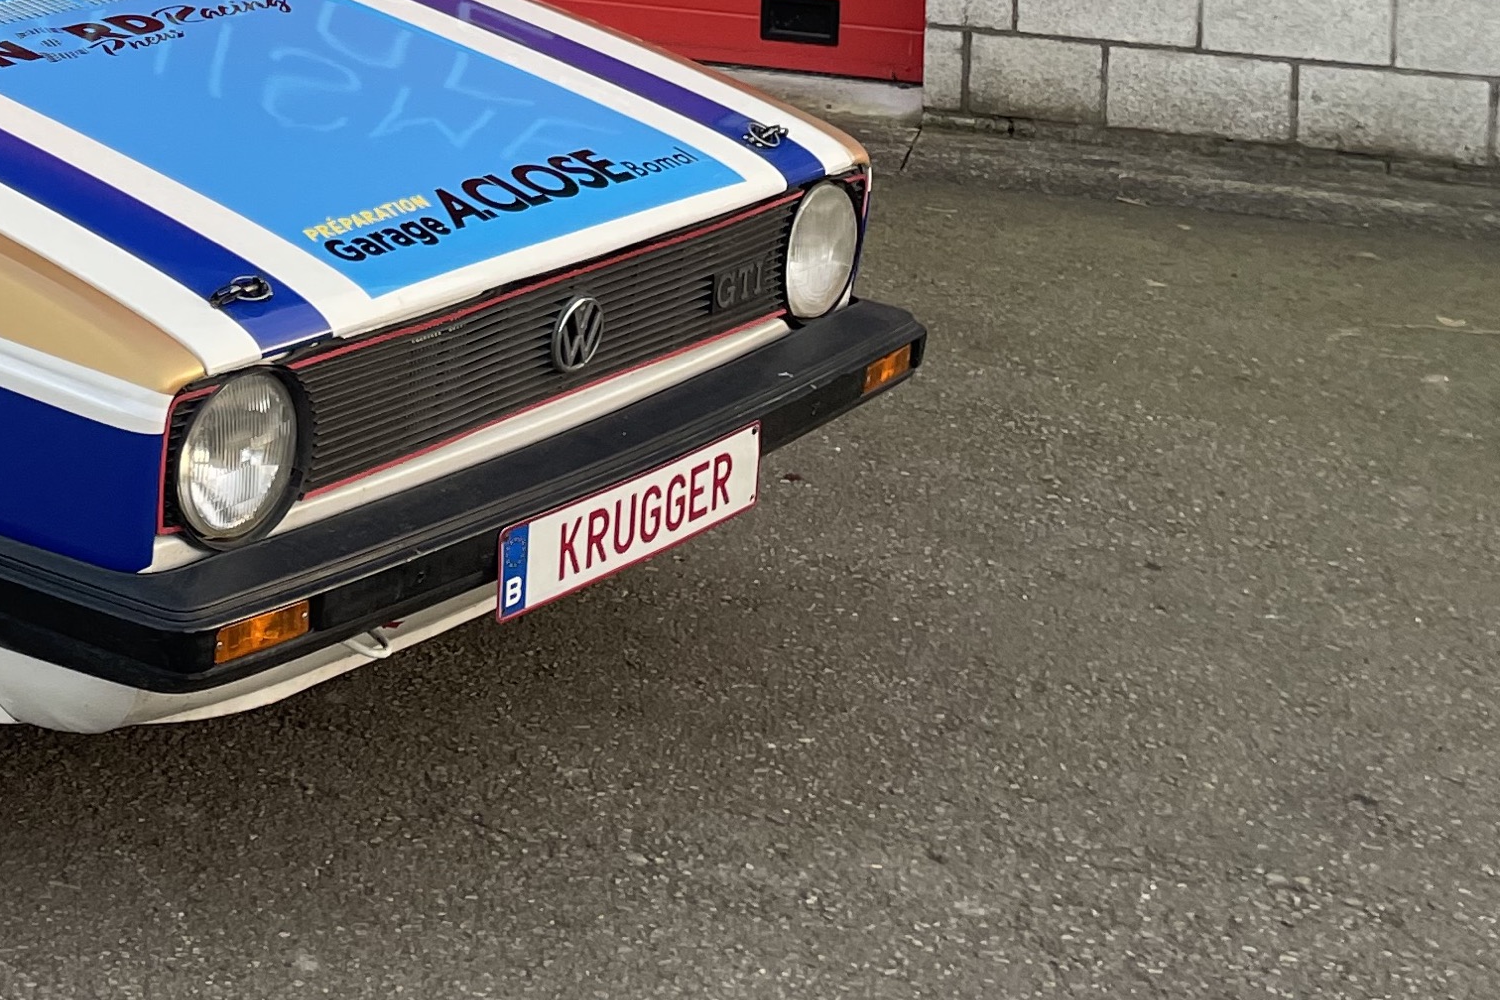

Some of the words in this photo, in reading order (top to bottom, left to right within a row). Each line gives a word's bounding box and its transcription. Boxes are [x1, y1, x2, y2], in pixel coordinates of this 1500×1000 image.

[88, 29, 185, 56] Pneus
[302, 194, 432, 243] PRÉPARATION
[324, 214, 452, 262] Garage
[623, 146, 699, 177] Bomal
[717, 260, 766, 309] GTI
[558, 452, 733, 581] KRUGGER
[505, 576, 522, 608] B
